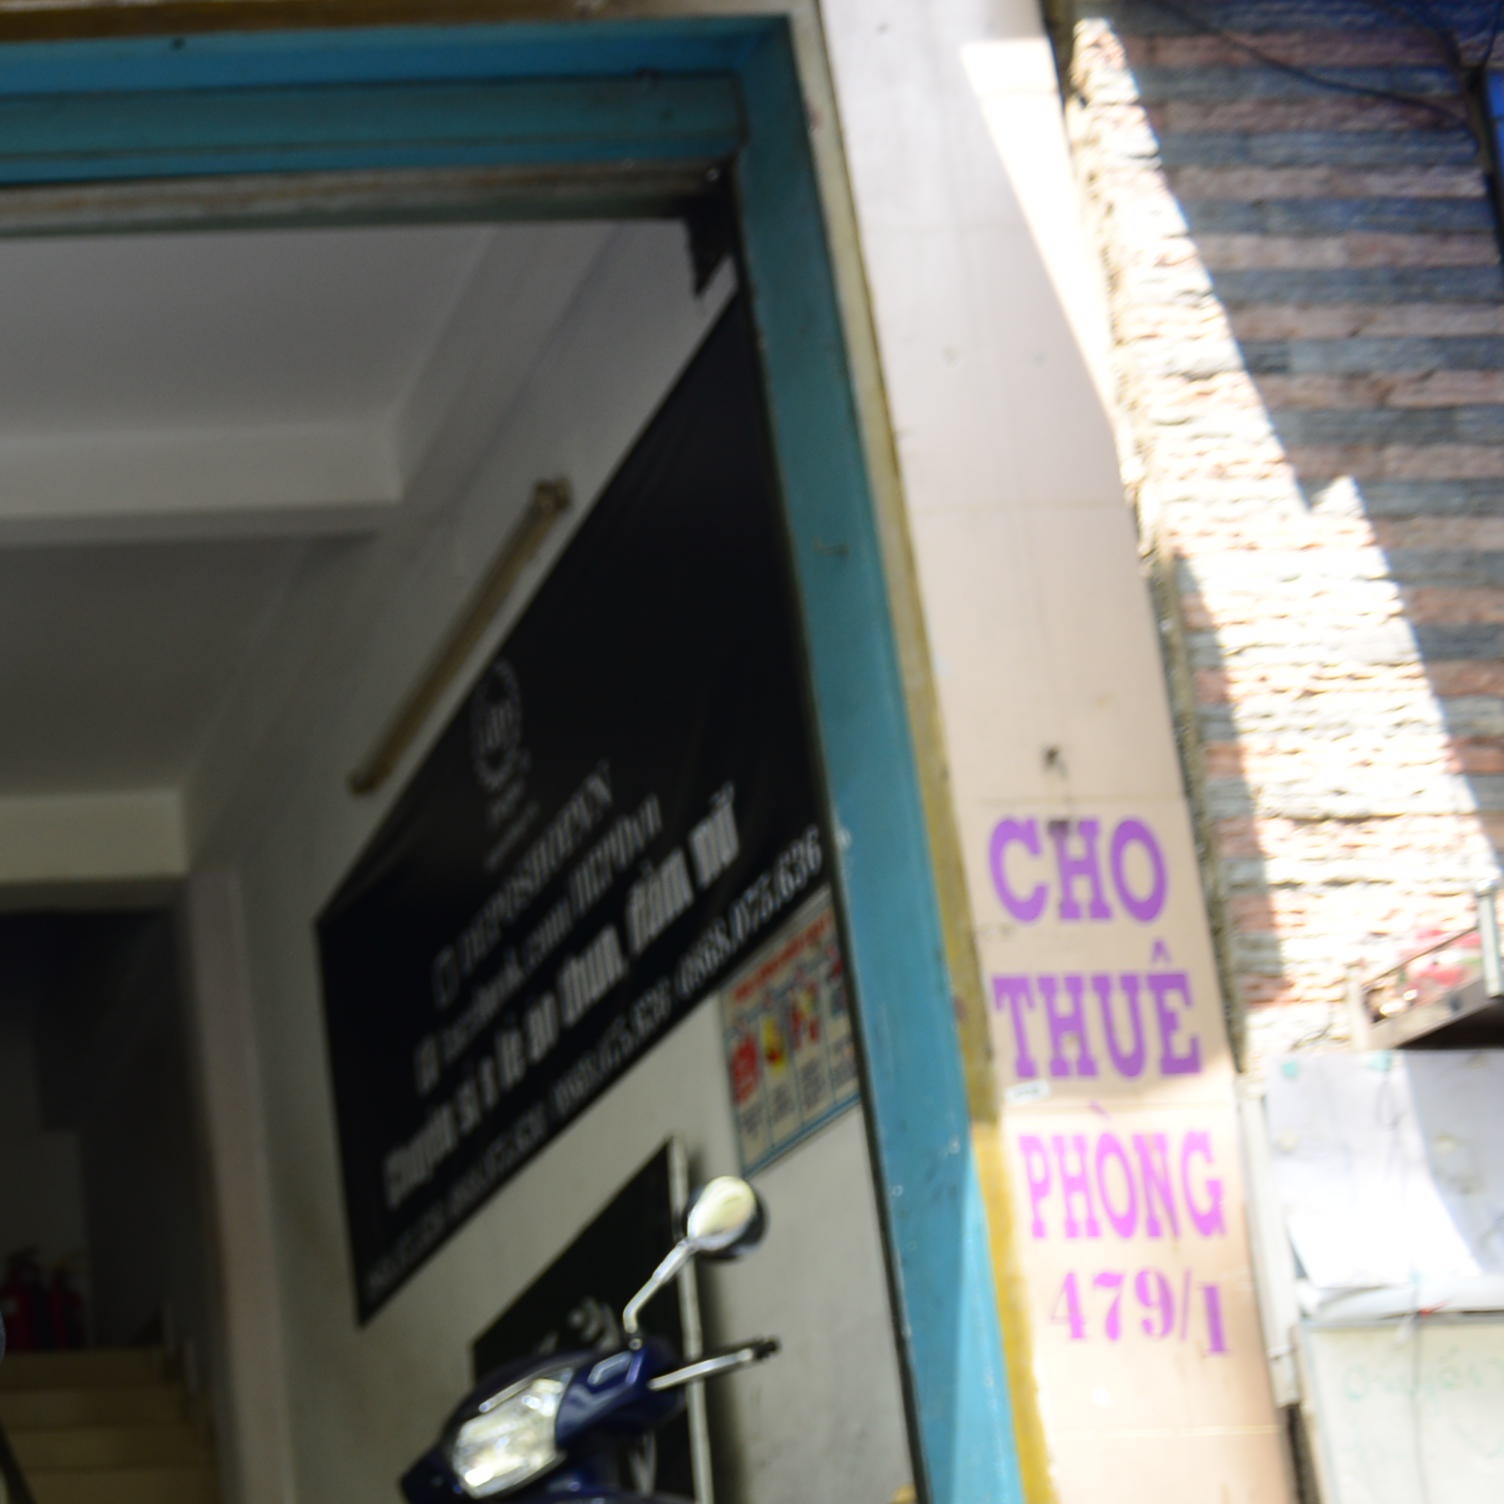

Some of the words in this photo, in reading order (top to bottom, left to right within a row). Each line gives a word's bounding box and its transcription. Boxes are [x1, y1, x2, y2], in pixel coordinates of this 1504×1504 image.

[989, 817, 1169, 923] CHO
[992, 938, 1203, 1080] THUÊ
[1017, 1100, 1226, 1241] PHÒNG
[1049, 1265, 1231, 1357] 479/1
